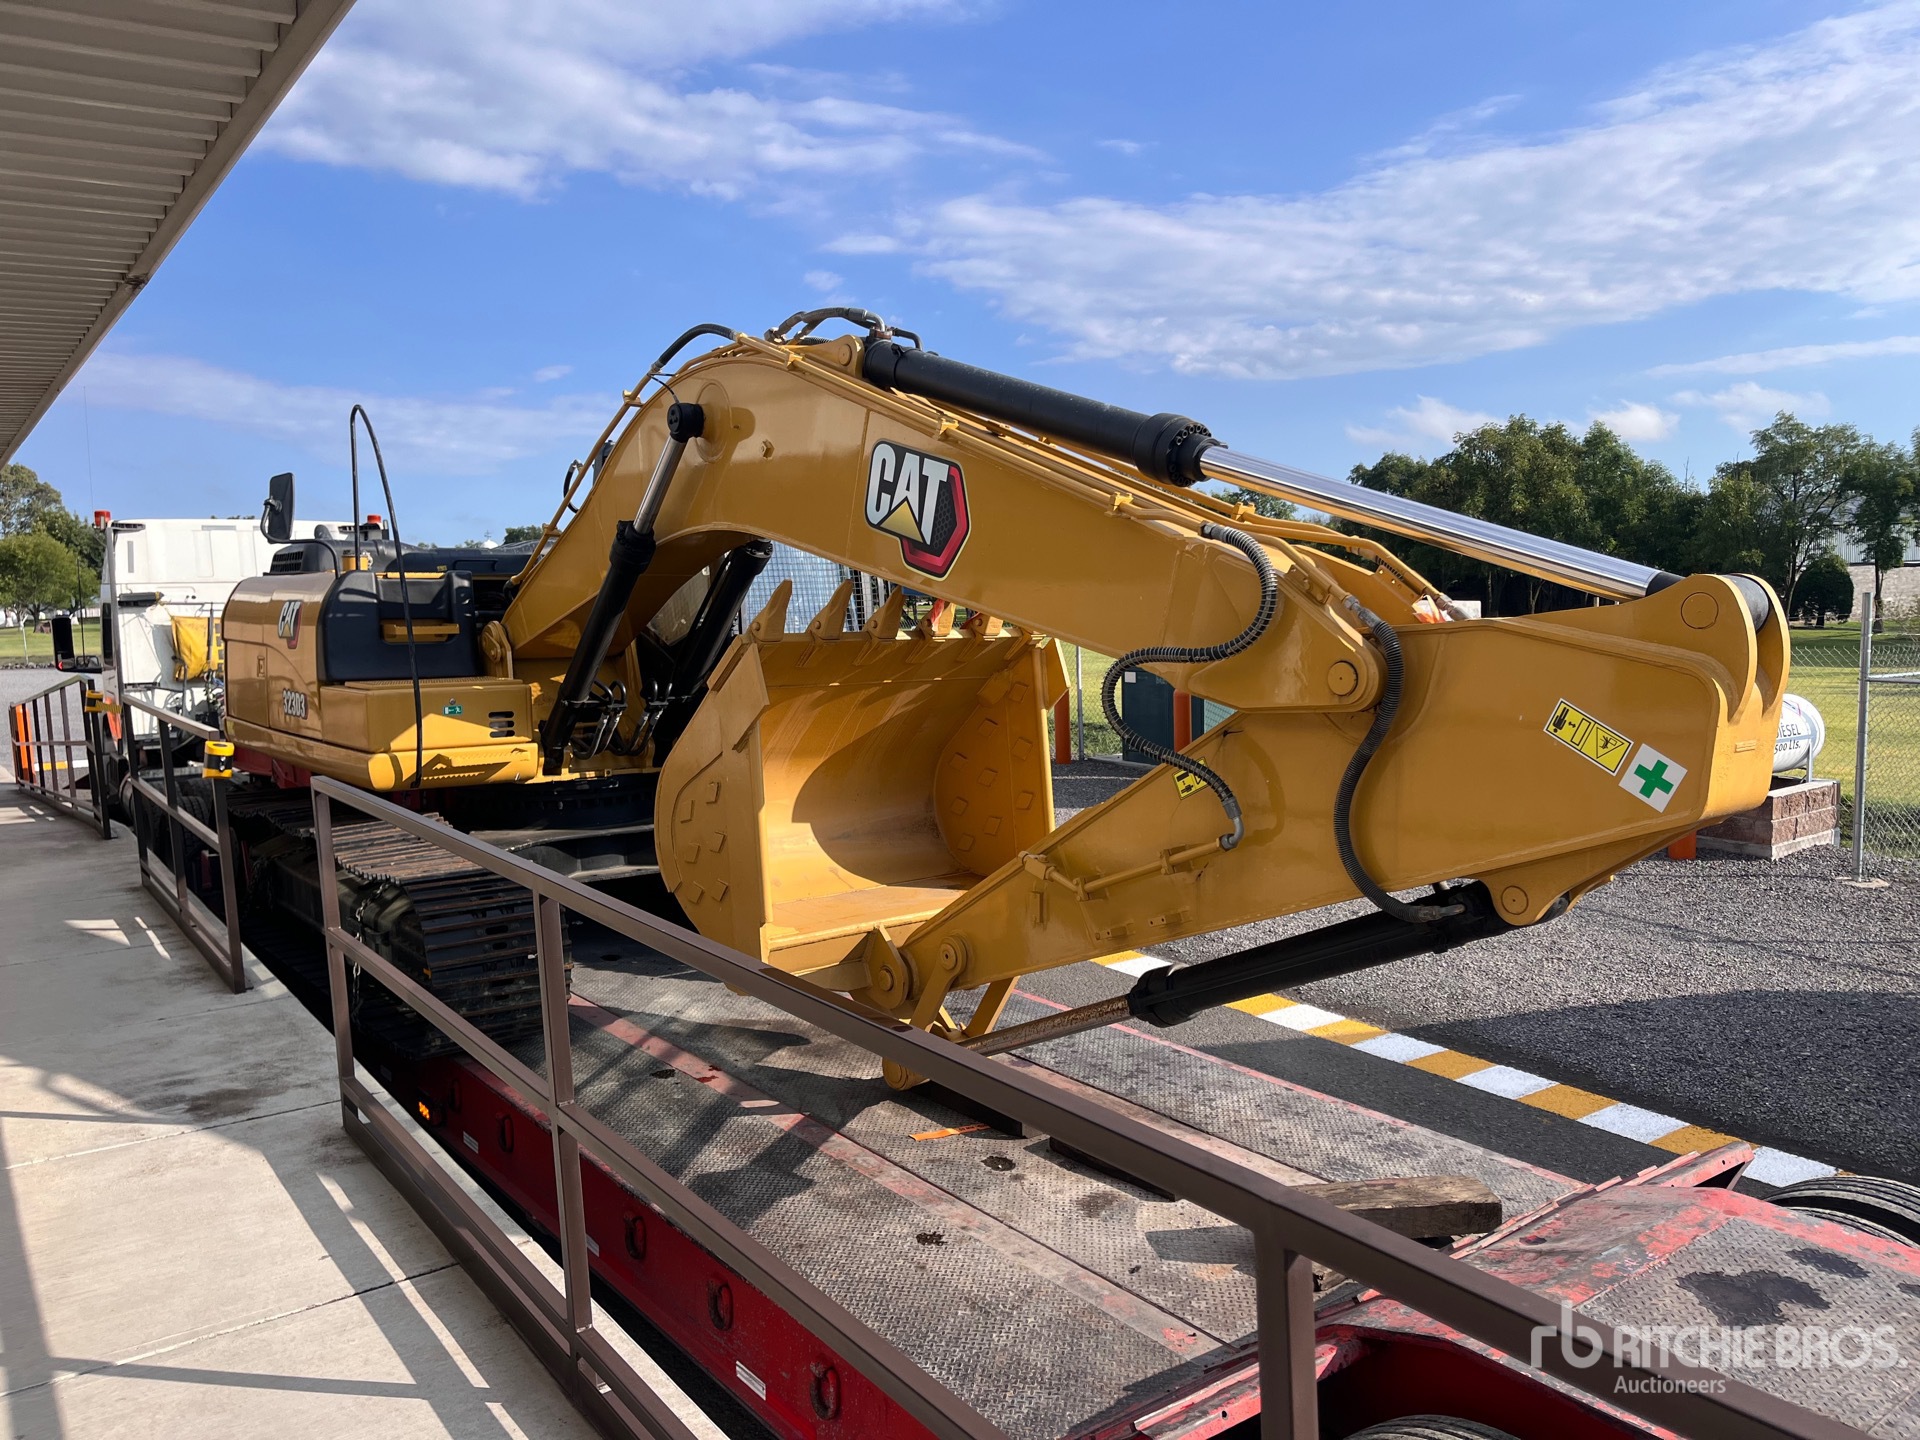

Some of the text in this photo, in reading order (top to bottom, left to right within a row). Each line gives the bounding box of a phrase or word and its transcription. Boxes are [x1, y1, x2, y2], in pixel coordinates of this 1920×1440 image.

[866, 443, 950, 546] CAT
[278, 601, 302, 639] CAT
[283, 689, 306, 718] 323D3
